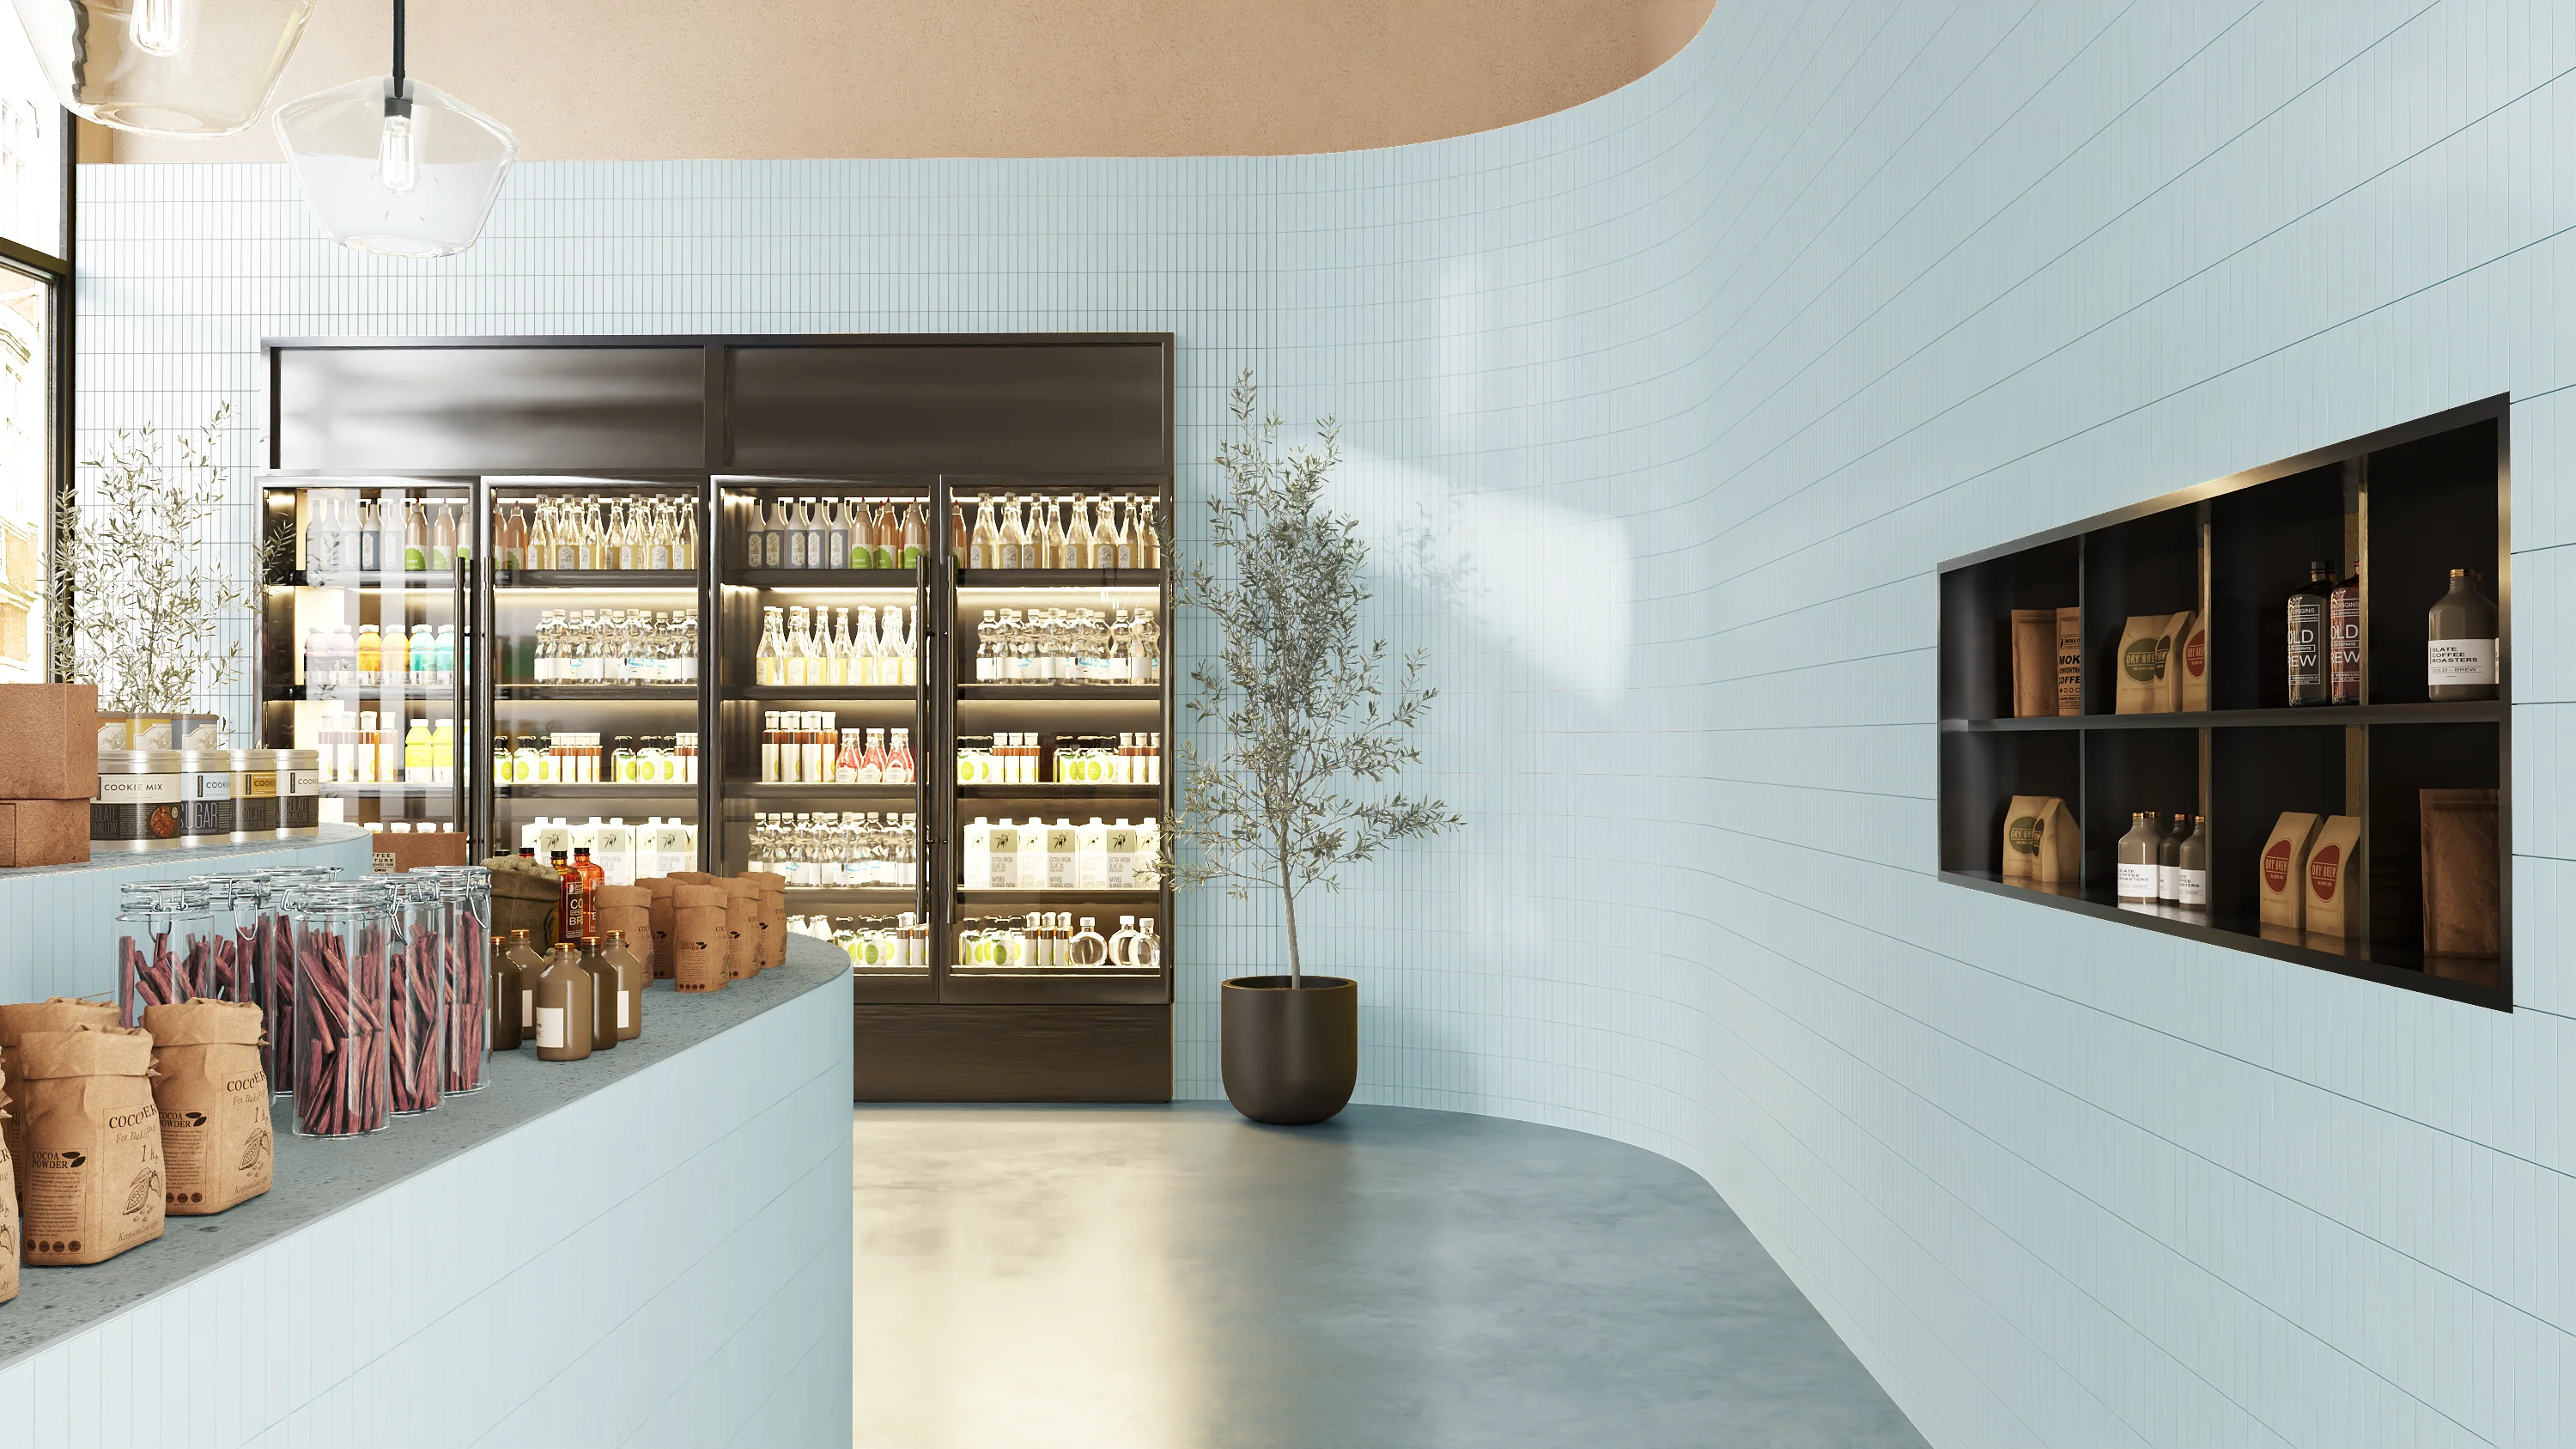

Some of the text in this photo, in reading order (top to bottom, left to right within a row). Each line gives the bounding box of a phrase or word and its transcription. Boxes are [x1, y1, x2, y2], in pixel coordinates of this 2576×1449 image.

[2287, 630, 2314, 643] OLD
[2330, 624, 2359, 640] OLD
[2059, 655, 2080, 665] MOK
[2126, 654, 2140, 664] DRY
[2142, 654, 2155, 663] BRE
[2287, 654, 2317, 667] REW
[2330, 651, 2360, 663] REW
[2059, 675, 2080, 685] OFFE
[2312, 864, 2323, 876] DRY
[570, 898, 583, 910] CO
[569, 916, 583, 926] BR
[116, 1133, 128, 1144] For
[32, 1152, 59, 1160] COCOA
[32, 1160, 68, 1168] POWDER
